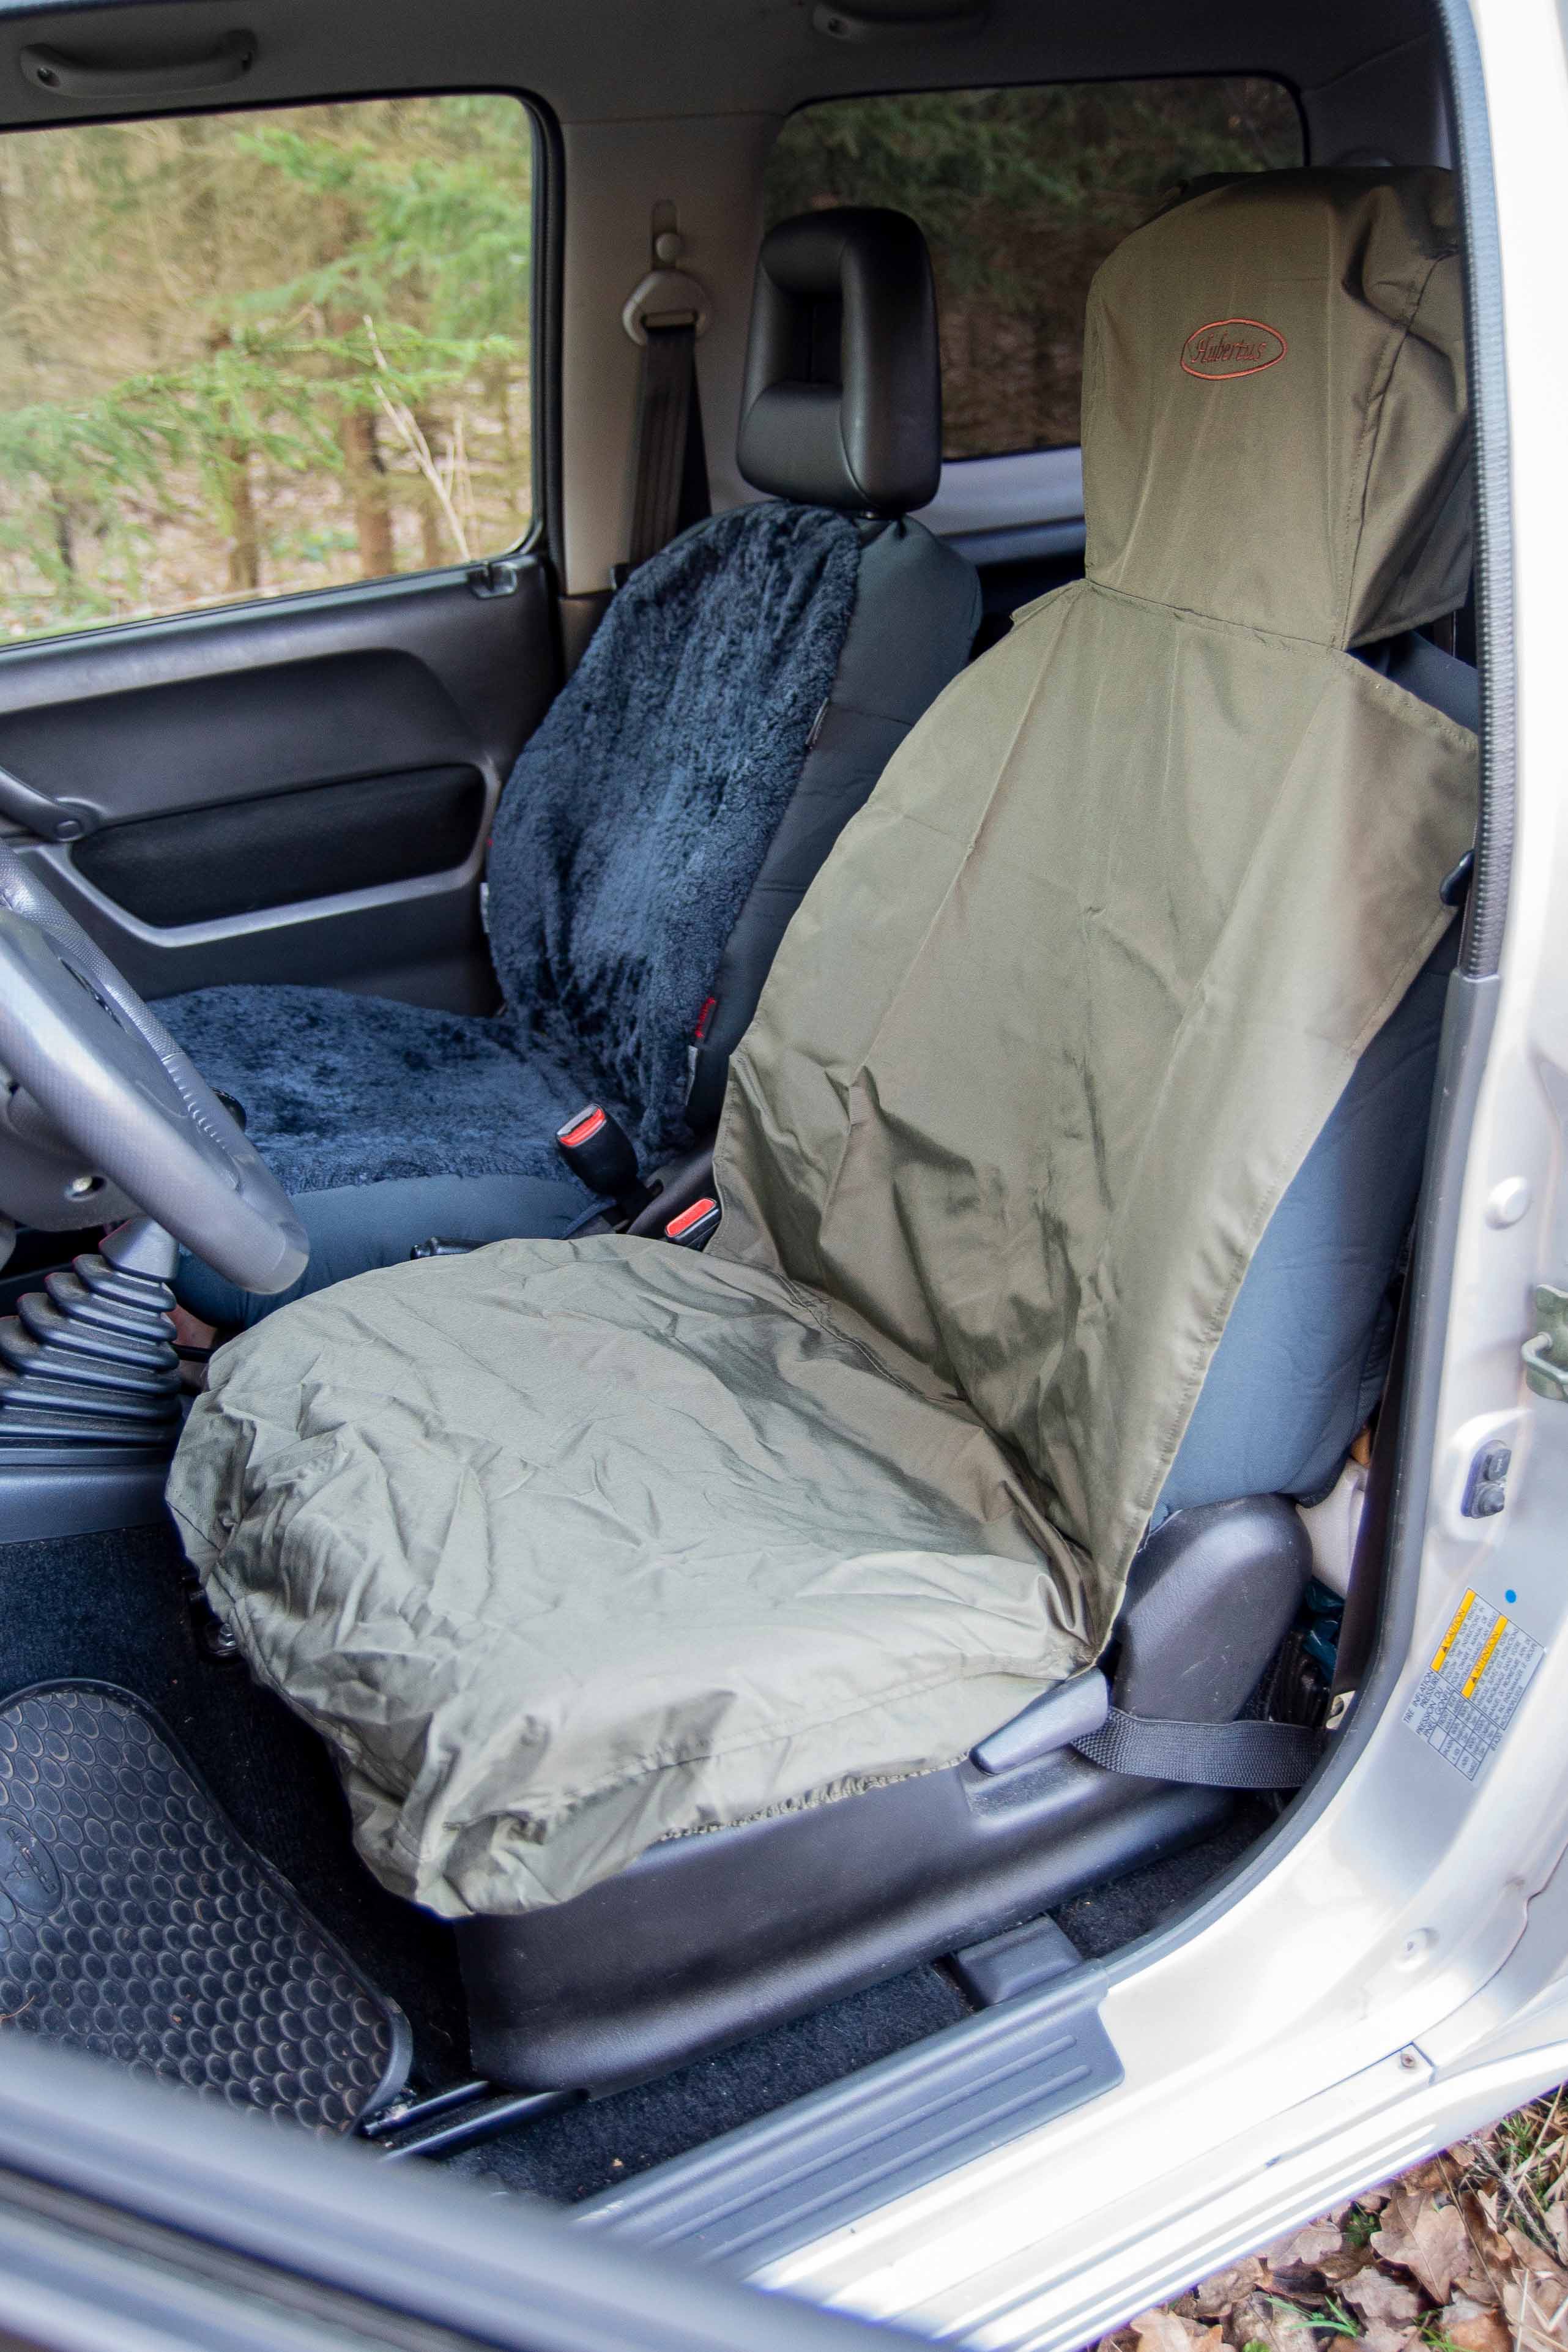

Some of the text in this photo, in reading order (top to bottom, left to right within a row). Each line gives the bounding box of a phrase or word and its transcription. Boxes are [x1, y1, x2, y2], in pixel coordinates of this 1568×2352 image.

[1191, 330, 1267, 363] Hubertus
[1444, 1607, 1466, 1645] CAUTION
[1473, 1629, 1500, 1675] ATTENTION
